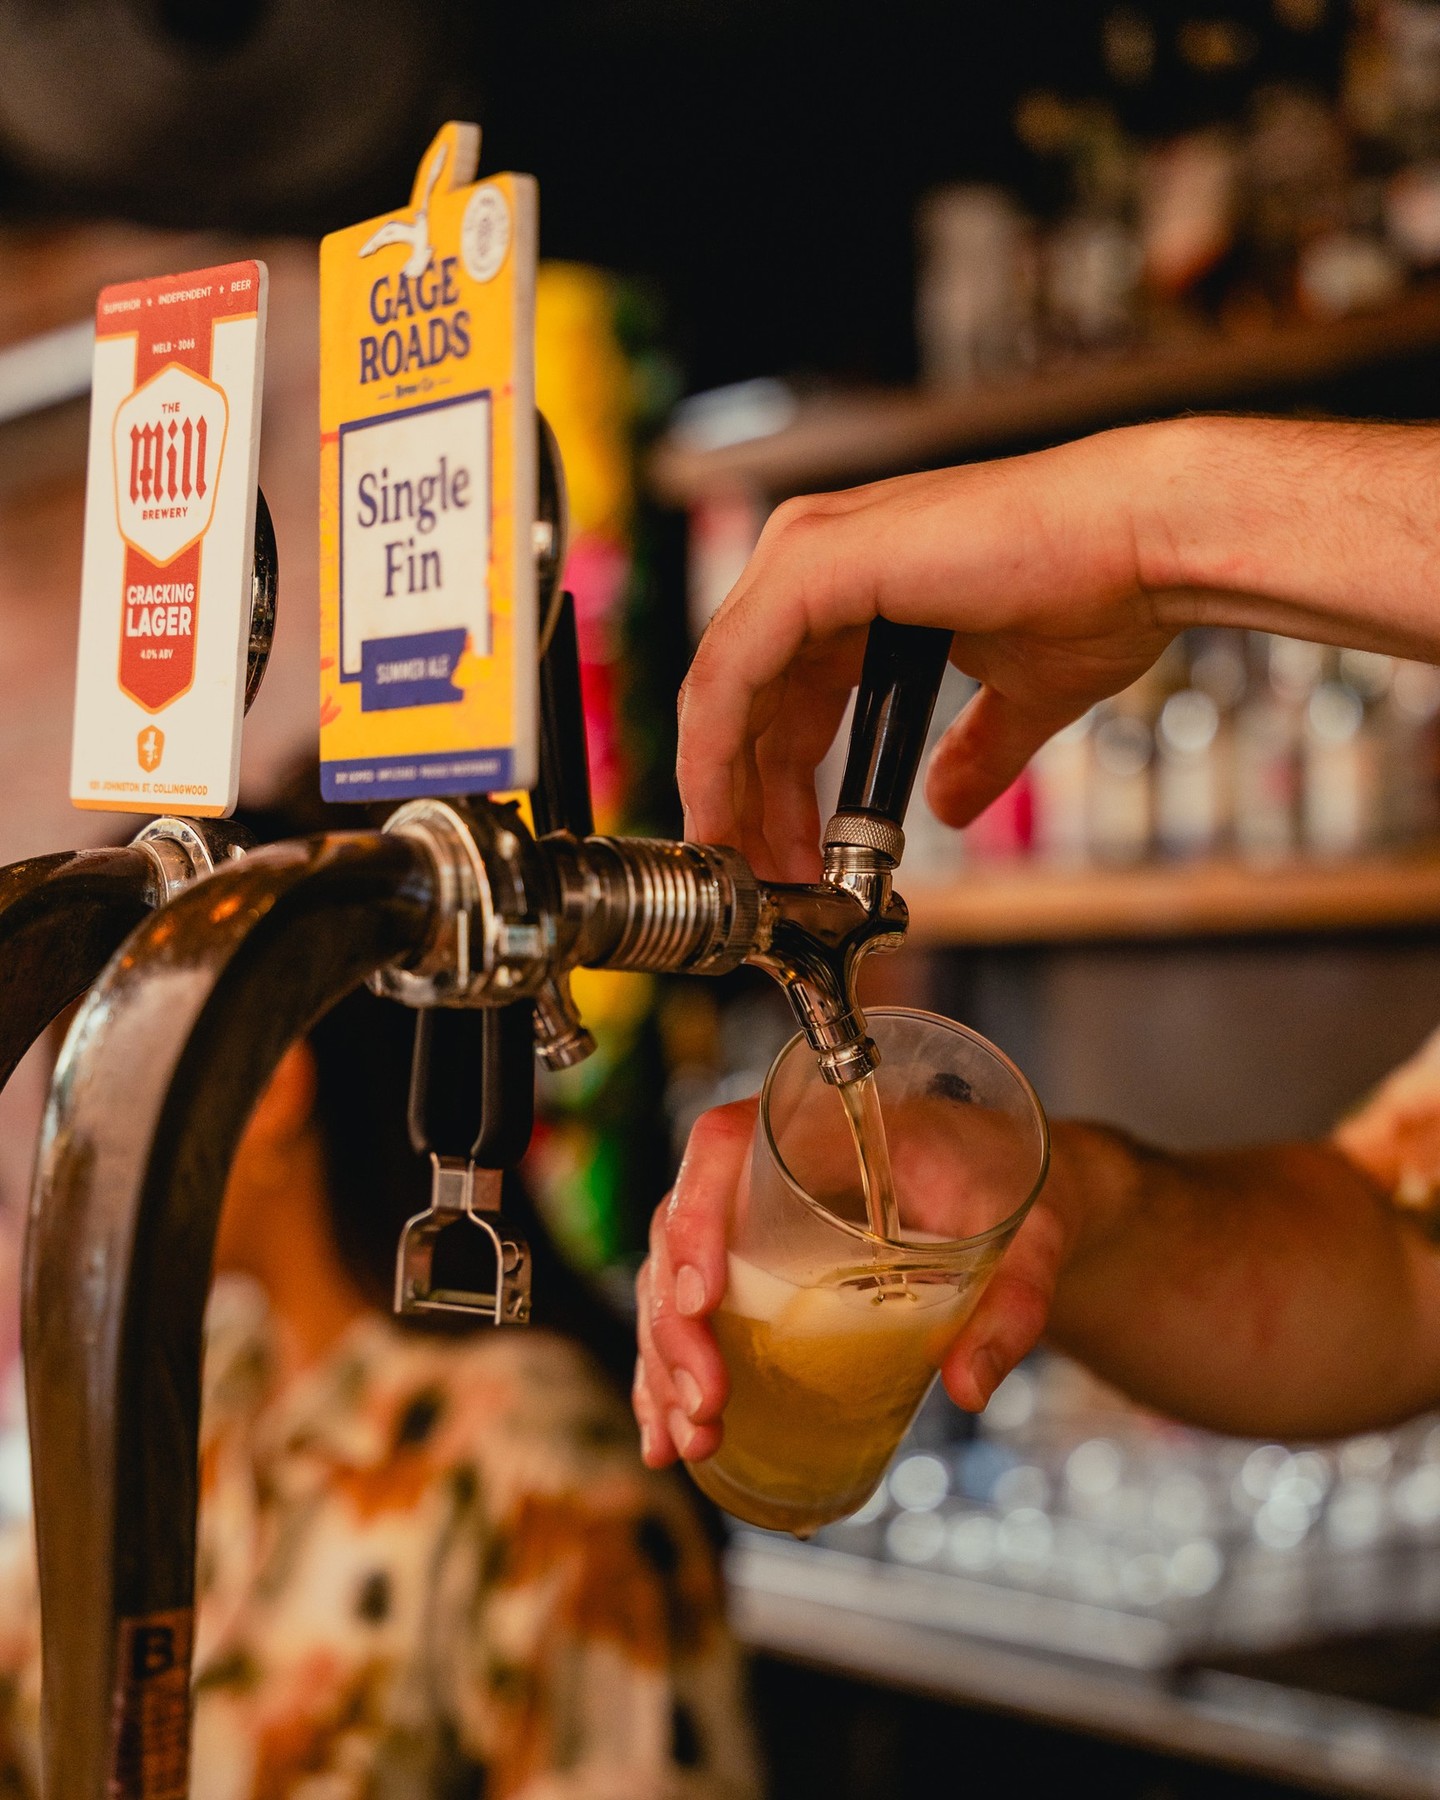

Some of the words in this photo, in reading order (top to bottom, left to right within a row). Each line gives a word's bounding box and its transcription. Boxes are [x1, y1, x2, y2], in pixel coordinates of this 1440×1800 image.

[103, 299, 141, 314] SUPERIOR
[158, 286, 212, 305] INDEPENDENT
[231, 279, 251, 292] BEER
[370, 256, 459, 326] GAGE
[360, 310, 471, 385] ROADS
[162, 402, 181, 414] THE
[357, 456, 470, 535] Single
[142, 507, 189, 521] BREWERY
[384, 538, 442, 598] Fin
[126, 583, 195, 606] CRACKING
[126, 606, 192, 637] LAGER
[159, 649, 174, 660] ABV
[376, 657, 425, 685] SUMMER
[427, 653, 450, 678] ALE
[103, 781, 140, 792] JOHNSTON
[153, 783, 209, 796] COLLINGWOOD
